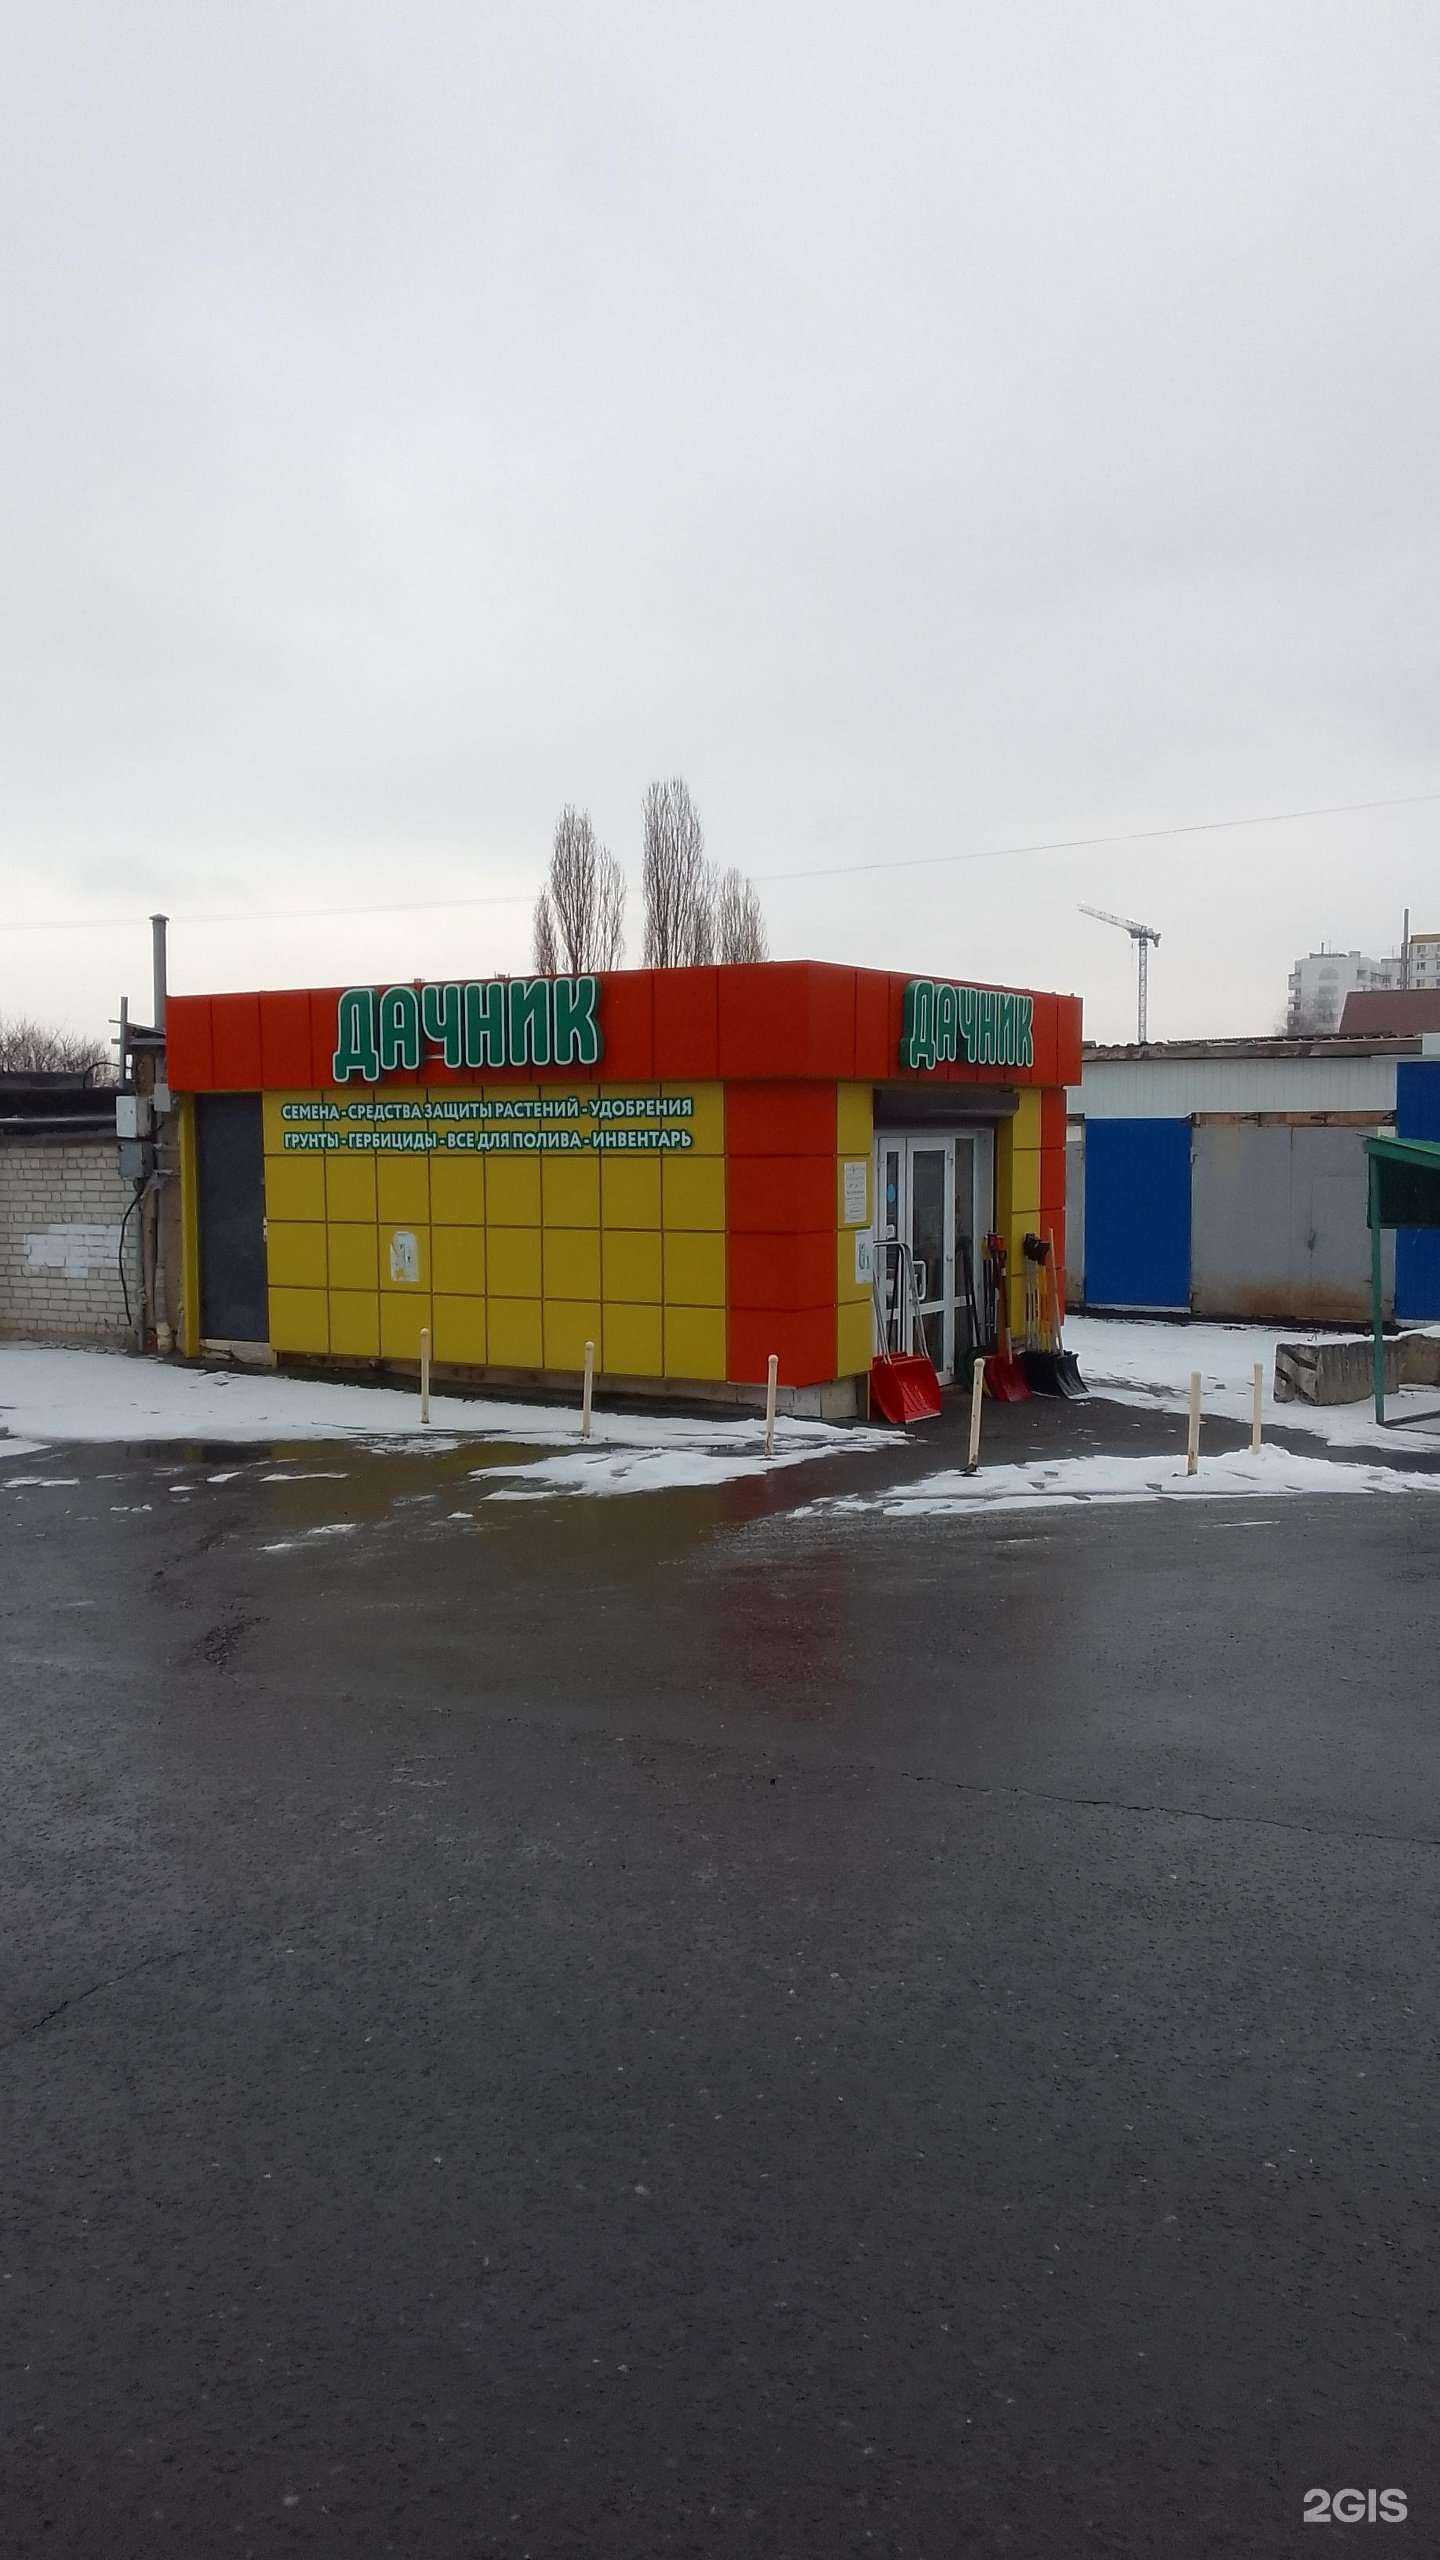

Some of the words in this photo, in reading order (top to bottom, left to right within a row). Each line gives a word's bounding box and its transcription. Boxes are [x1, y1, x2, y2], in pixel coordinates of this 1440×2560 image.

[333, 976, 598, 1082] ДАЧНИК
[907, 980, 1034, 1070] ДАЧНИК
[281, 1104, 340, 1120] СЕМЕНА
[347, 1103, 421, 1122] СРЕДСТВА
[424, 1102, 492, 1121] ЗАЩИТЫ
[496, 1098, 579, 1118] РАСТЕНИЙ
[589, 1099, 693, 1118] УДОБРЕНИЯ
[284, 1133, 339, 1149] ГРУНТЫ
[348, 1132, 437, 1150] ГЕРБИЦИДЫ
[447, 1133, 475, 1148] ВСЕ
[477, 1132, 510, 1151] ДЛЯ
[513, 1131, 582, 1149] ПОЛИВА
[592, 1131, 692, 1148] ИНВЕНТАРЬ
